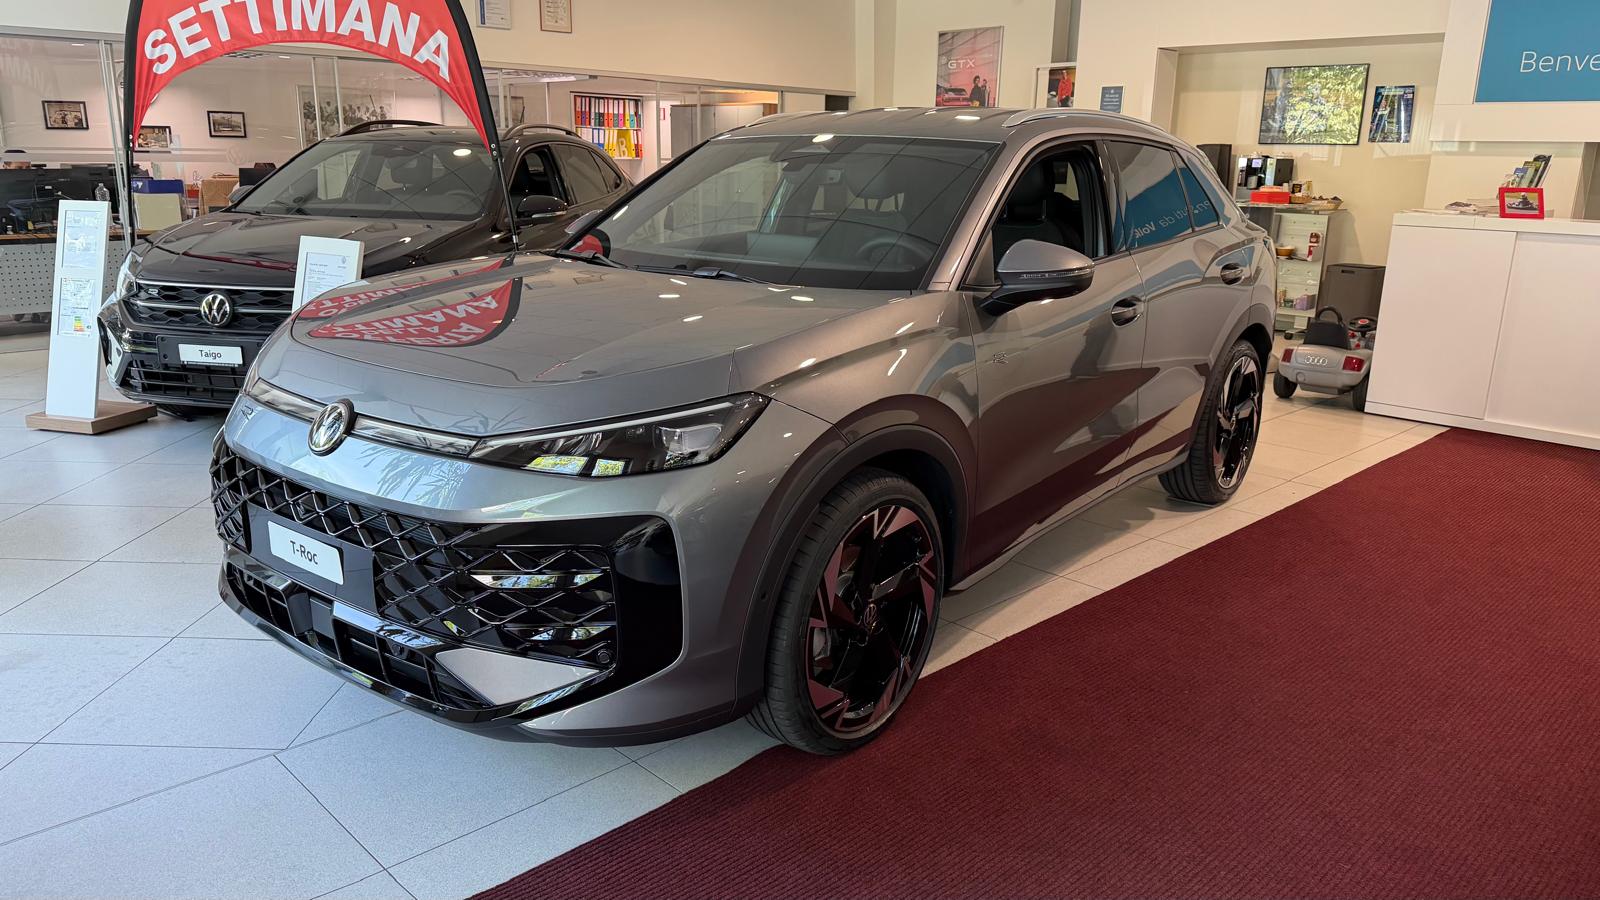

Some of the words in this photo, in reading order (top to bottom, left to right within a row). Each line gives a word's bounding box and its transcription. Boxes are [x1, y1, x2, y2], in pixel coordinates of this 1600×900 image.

[144, 0, 451, 83] SETTIMANA
[947, 58, 976, 69] GTX
[1519, 50, 1600, 73] Benve
[198, 349, 222, 360] Taigo
[289, 540, 319, 565] T-Roc
